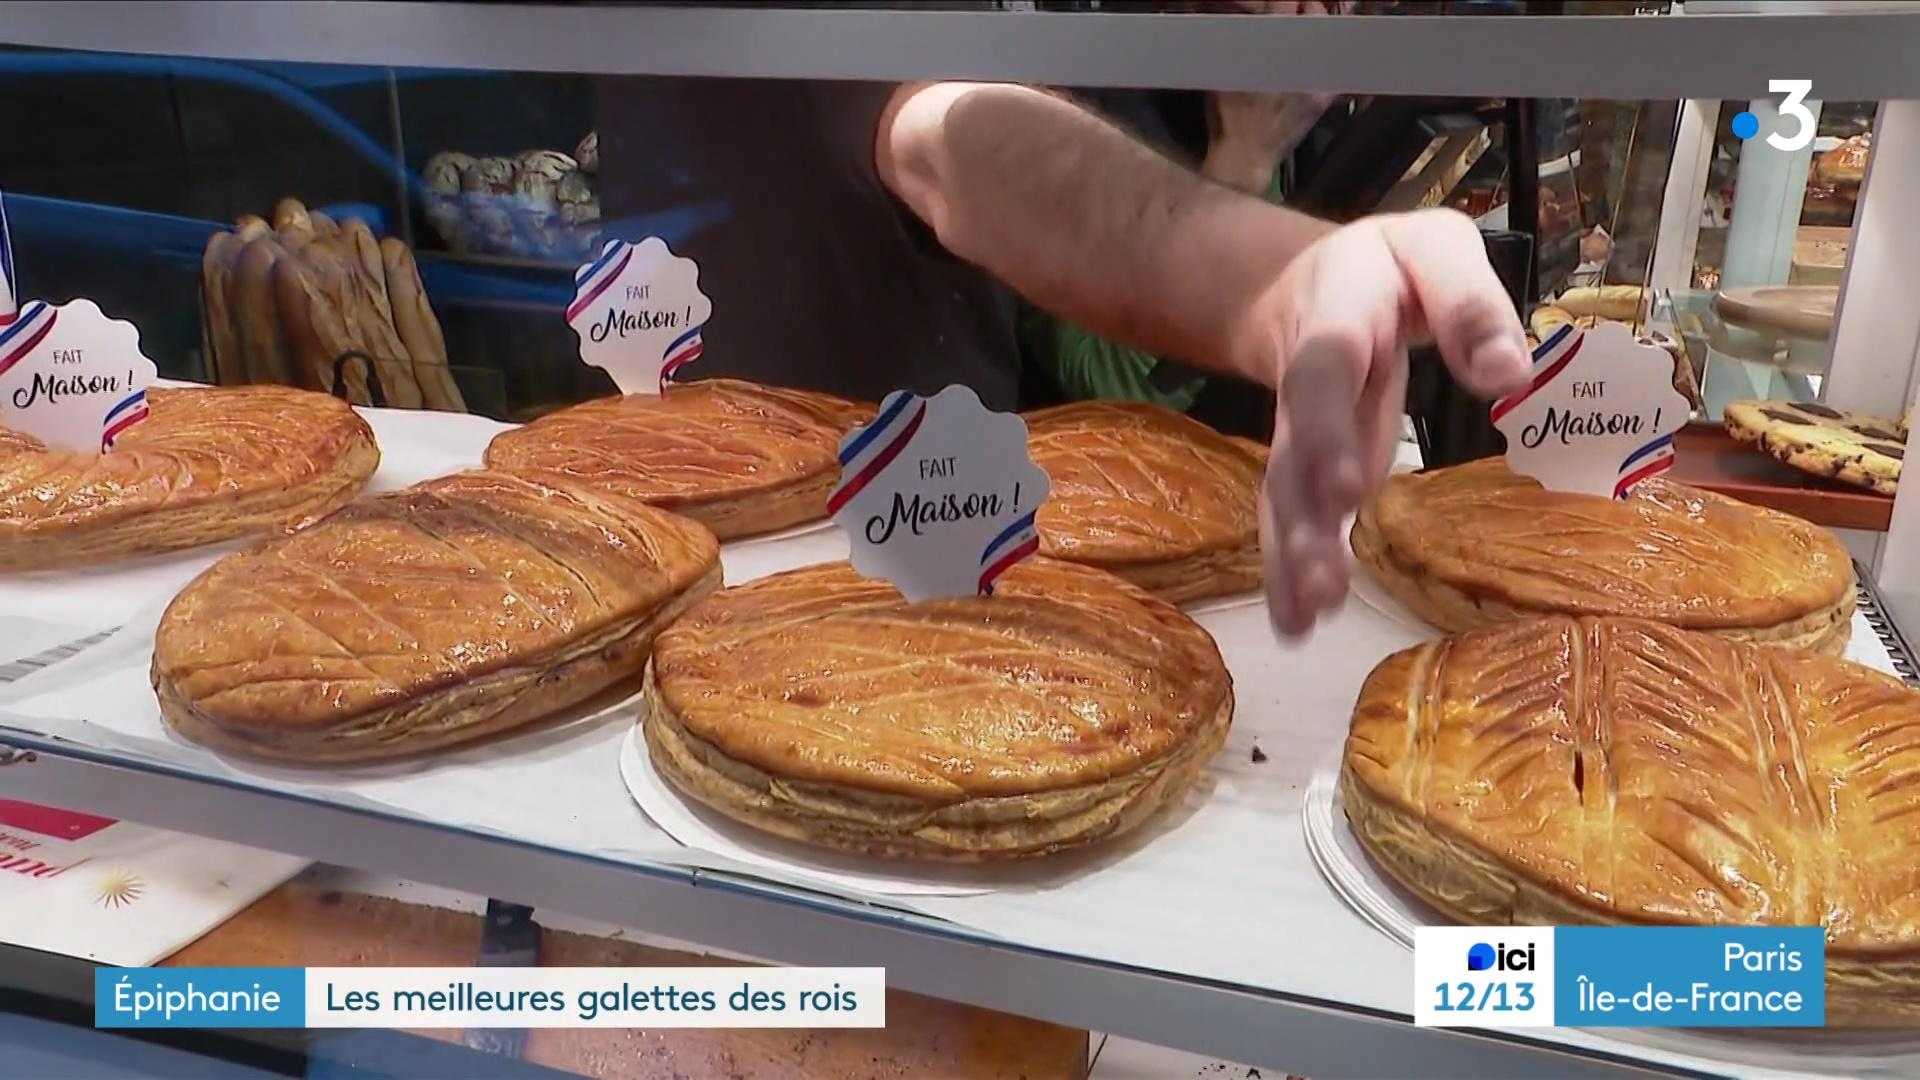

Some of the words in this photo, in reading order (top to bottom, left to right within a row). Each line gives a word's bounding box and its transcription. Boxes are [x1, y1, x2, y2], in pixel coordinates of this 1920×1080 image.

[626, 286, 650, 300] FAIT
[590, 308, 678, 343] Maison
[53, 349, 83, 364] FAIT
[13, 373, 119, 409] Maison
[1572, 381, 1606, 398] FAIT
[1521, 407, 1643, 448] Maison
[919, 457, 956, 480] FAIT
[865, 492, 1003, 544] Maison
